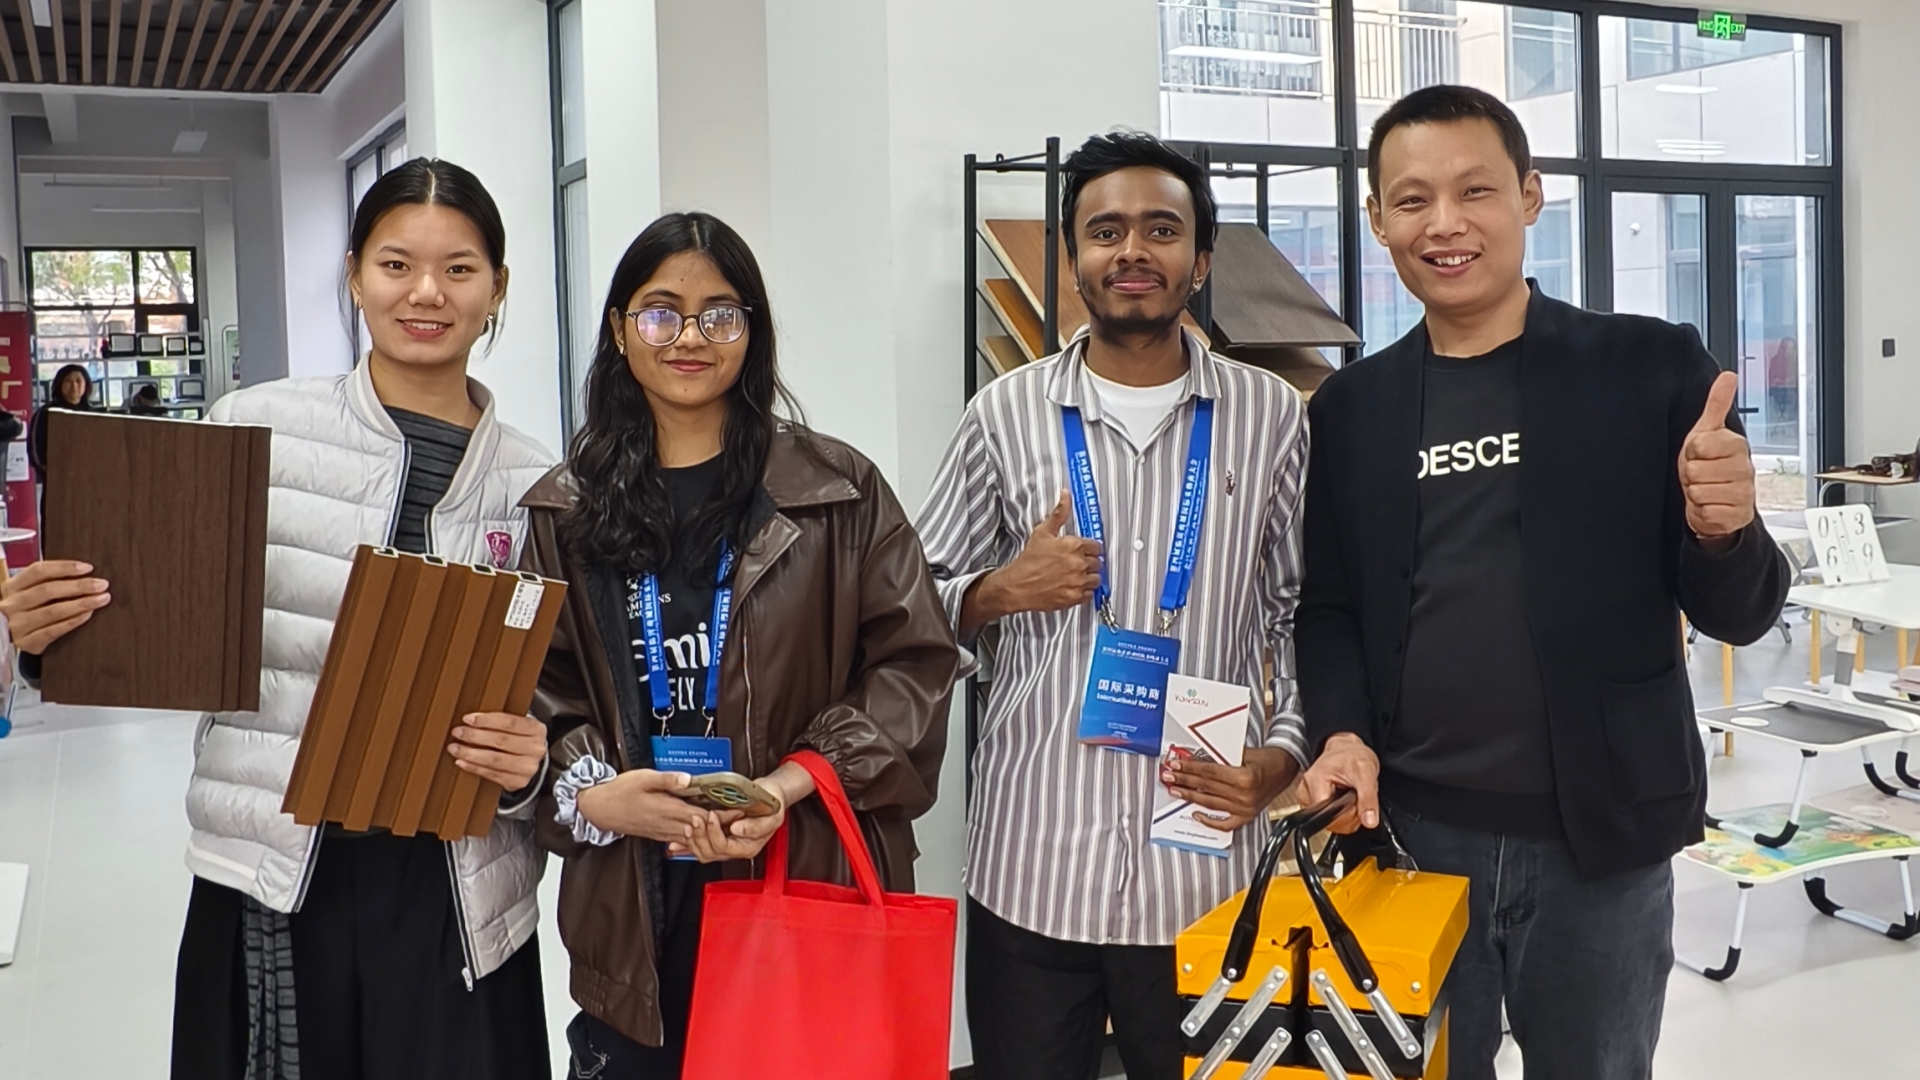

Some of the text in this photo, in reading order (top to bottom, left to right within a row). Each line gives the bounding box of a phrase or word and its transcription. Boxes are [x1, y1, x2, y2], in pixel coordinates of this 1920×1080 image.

[1097, 679, 1161, 701] 国际采购商
[1096, 692, 1159, 710] International Buyer
